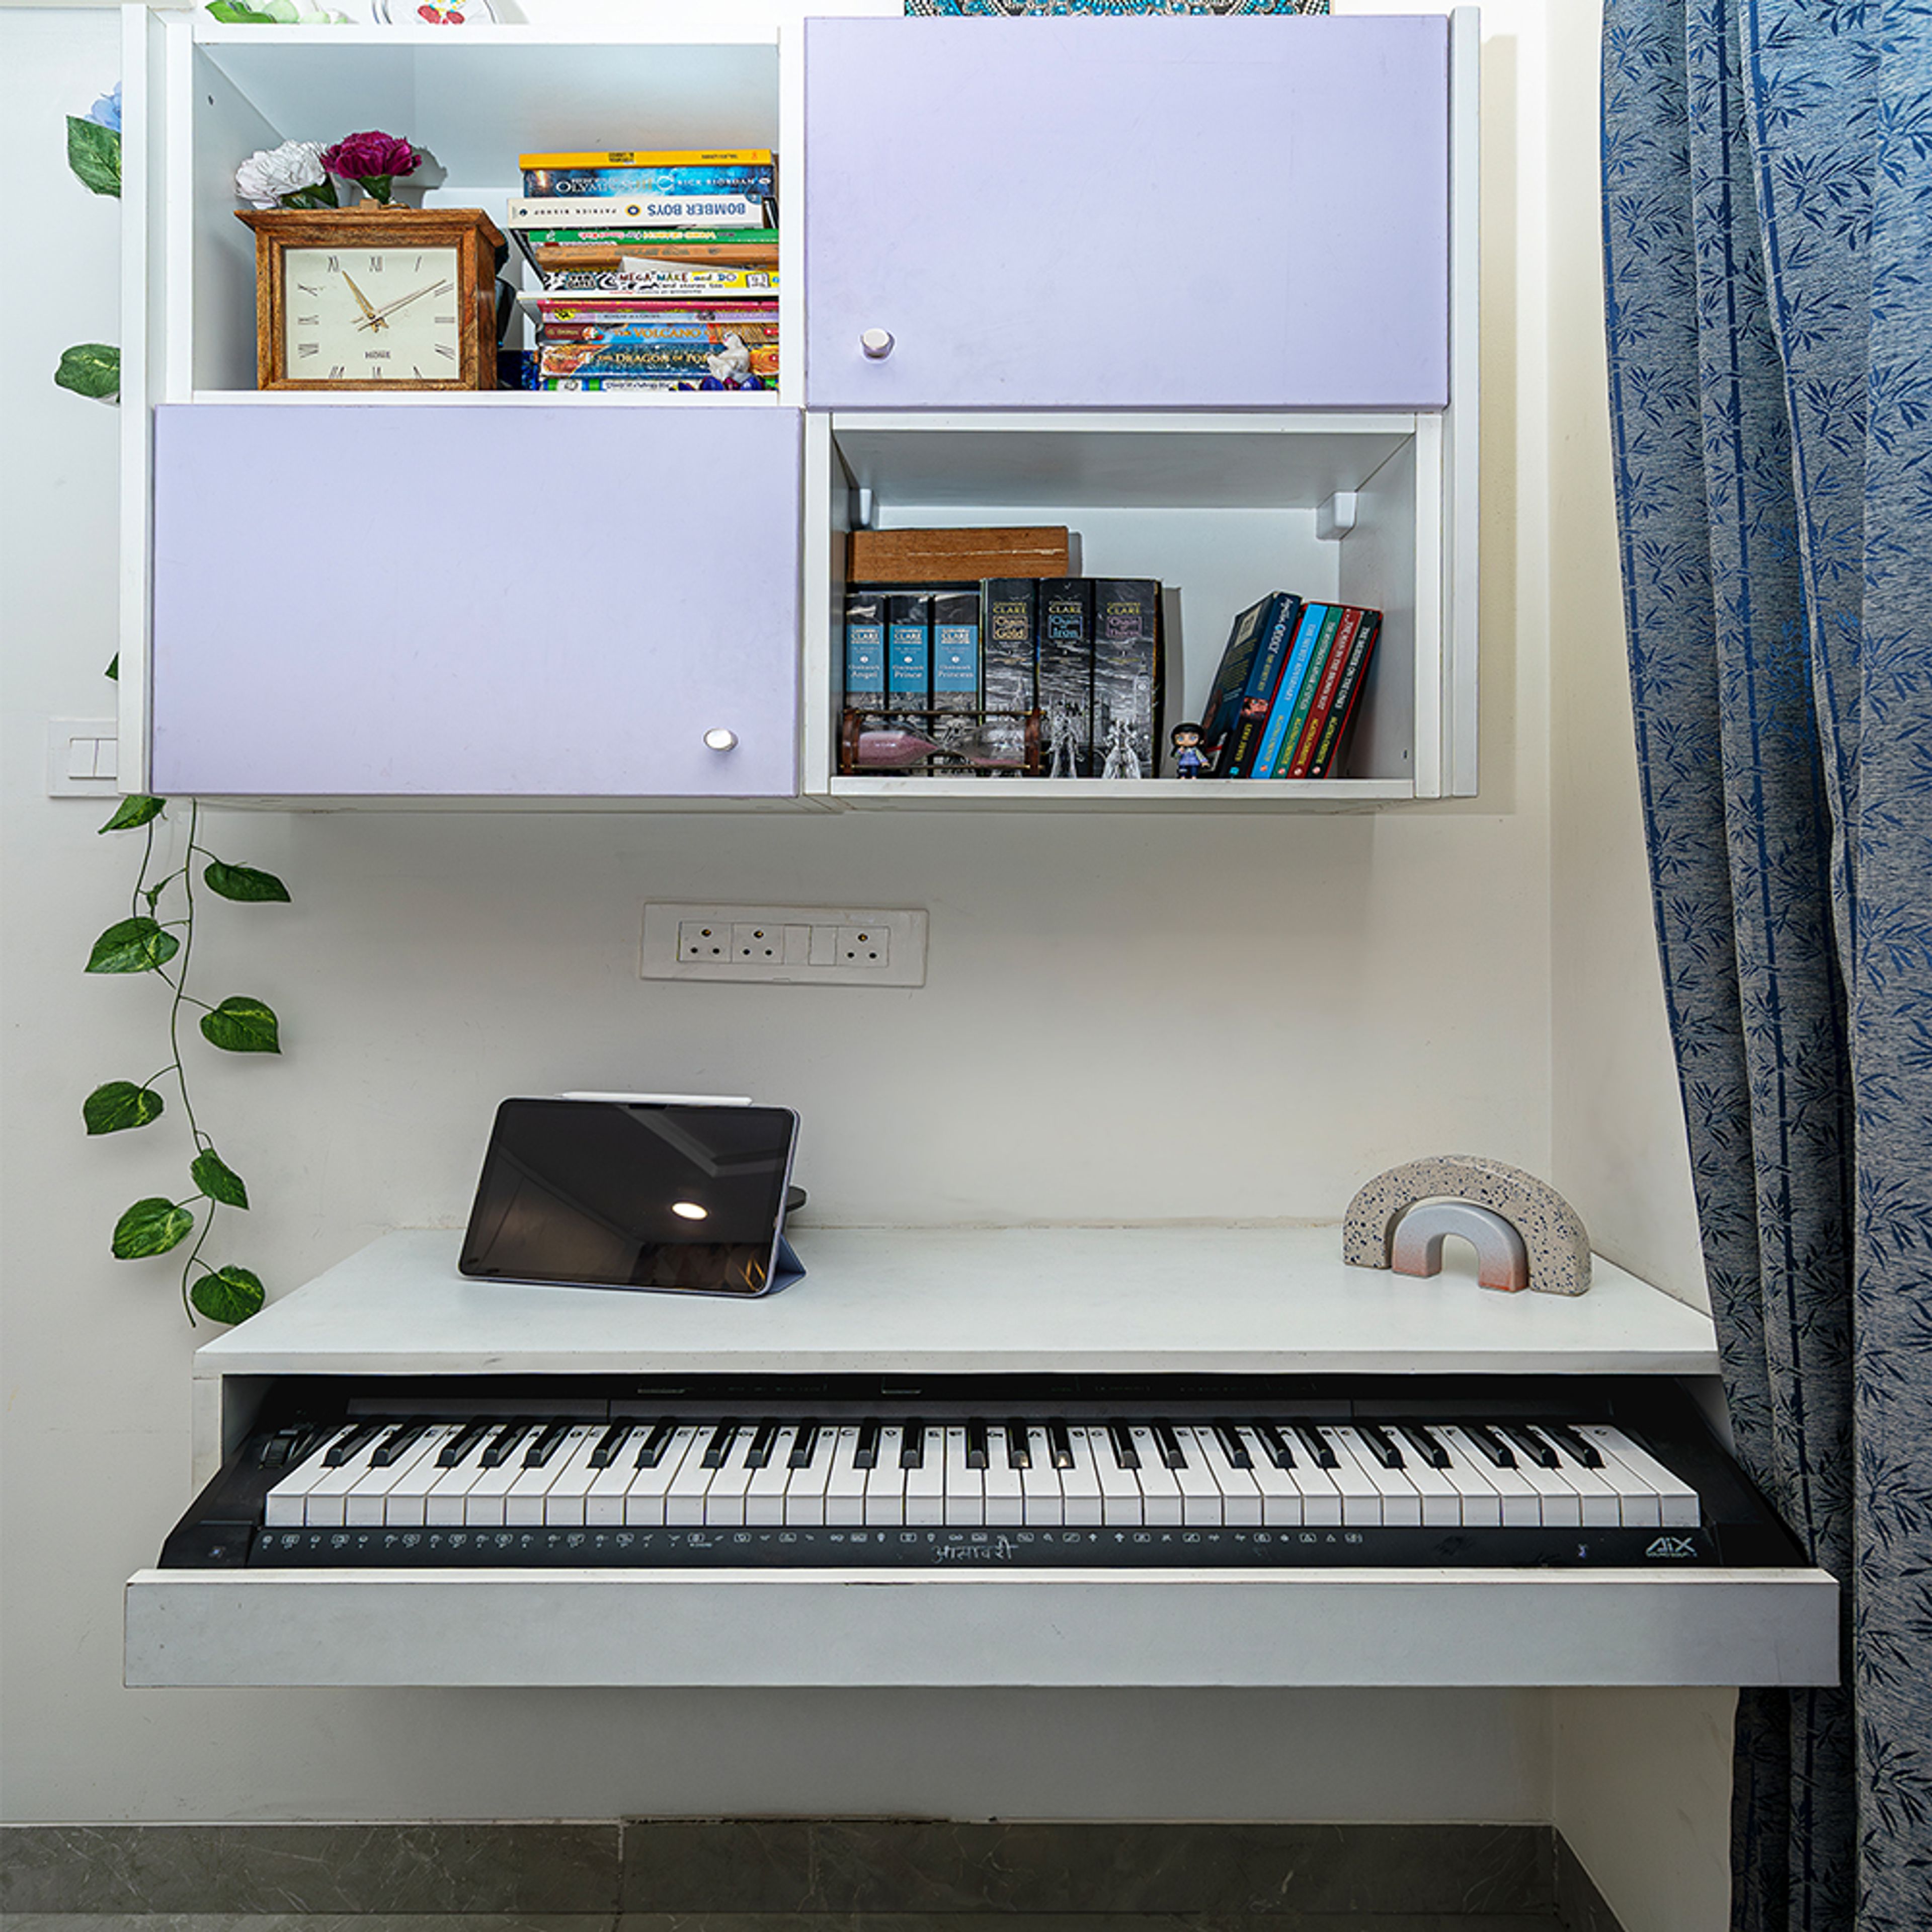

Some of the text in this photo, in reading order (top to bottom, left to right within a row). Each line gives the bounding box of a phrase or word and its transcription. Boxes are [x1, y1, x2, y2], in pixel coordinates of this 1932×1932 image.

[706, 177, 755, 186] RIORDAN
[647, 203, 746, 217] BOMBER BOYS
[620, 273, 652, 282] MEGA
[657, 273, 688, 282] MAKE
[718, 273, 737, 282] DO
[633, 328, 701, 339] VOLCANO
[615, 353, 670, 363] DRAGON
[993, 606, 1026, 614] CLARE
[1107, 607, 1140, 615] CLARE
[996, 627, 1023, 638] Gold
[1053, 627, 1078, 637] Iron
[851, 671, 878, 679] Angel
